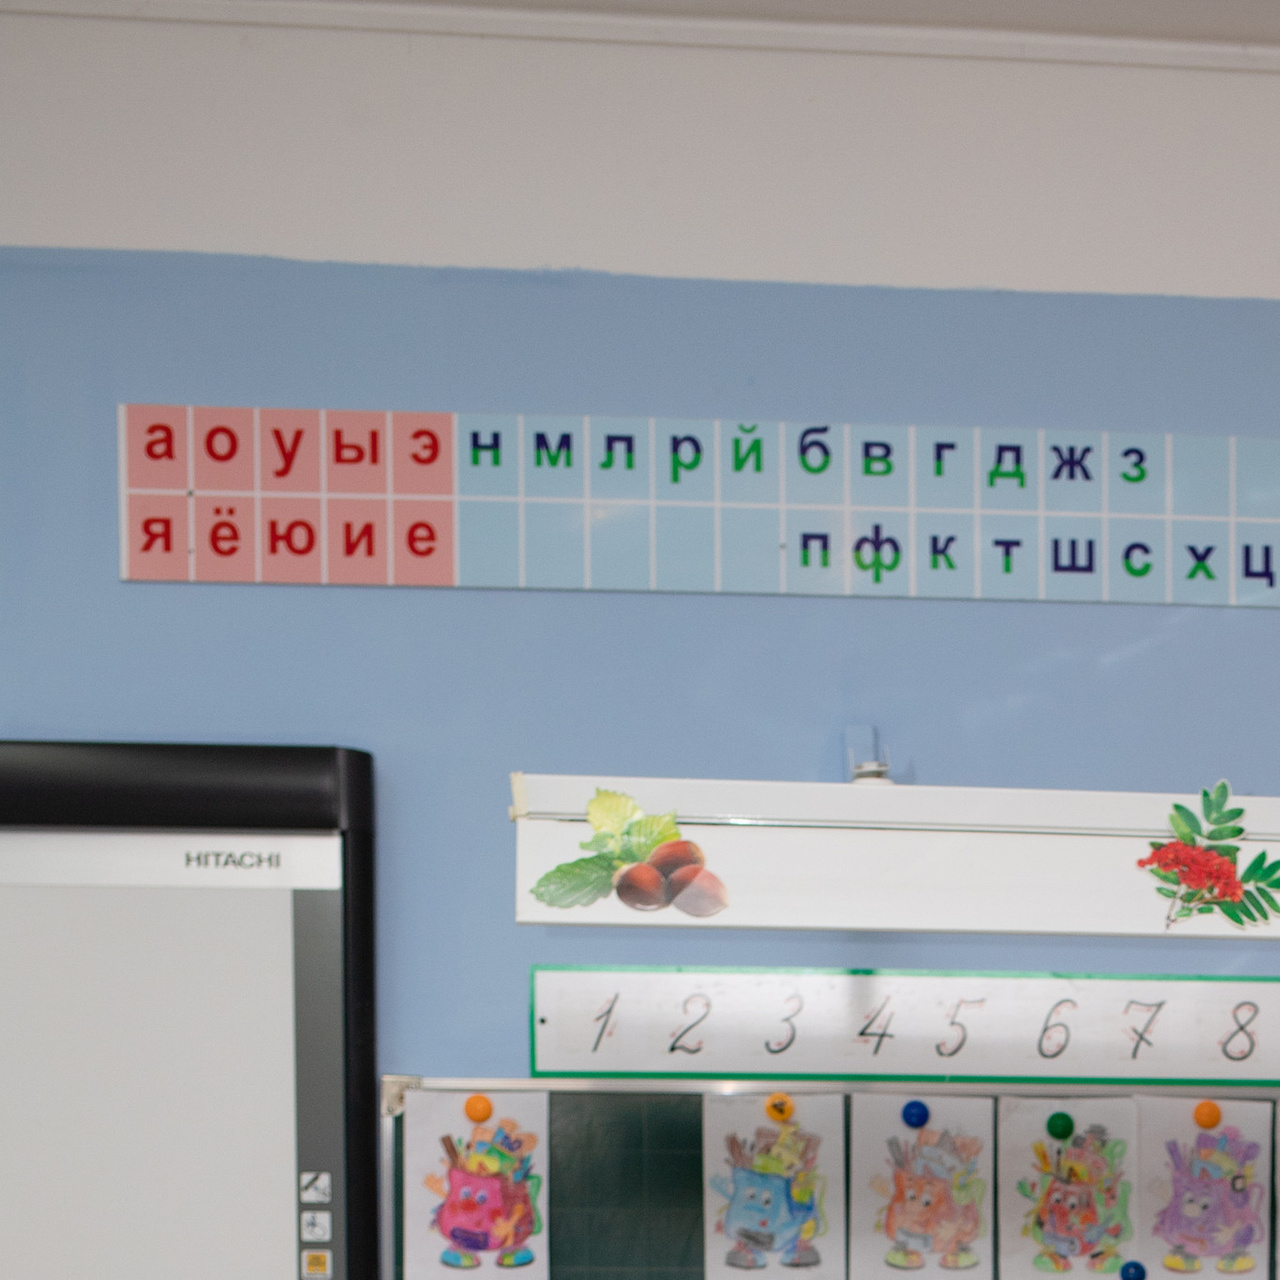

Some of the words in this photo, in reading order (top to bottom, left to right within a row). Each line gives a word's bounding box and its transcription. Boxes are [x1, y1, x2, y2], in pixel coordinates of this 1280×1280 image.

[143, 422, 176, 462] а
[204, 425, 239, 463] о
[272, 426, 304, 479] у
[332, 428, 380, 466] ы
[410, 428, 441, 466] э
[470, 430, 502, 467] н
[533, 431, 573, 468] м
[598, 433, 635, 471] л
[668, 433, 702, 484] р
[731, 423, 764, 474] й
[799, 426, 831, 475] б
[863, 441, 895, 477] в
[934, 442, 957, 478] г
[989, 444, 1026, 488] д
[1050, 446, 1093, 481] ж
[1121, 447, 1149, 483] з
[141, 517, 173, 553] я
[210, 508, 241, 557] ё
[268, 520, 315, 555] ю
[344, 522, 375, 557] и
[406, 521, 437, 557] е
[801, 533, 830, 567] п
[854, 525, 902, 583] ф
[931, 535, 957, 571] к
[994, 538, 1023, 574] т
[1052, 538, 1097, 574] ш
[1122, 541, 1152, 578] с
[1186, 543, 1217, 581] х
[1243, 545, 1275, 588] ц
[185, 852, 281, 868] HITACHI
[592, 993, 618, 1054] 1
[669, 994, 711, 1056] 2
[765, 994, 804, 1055] 3
[858, 994, 896, 1057] 4
[935, 999, 985, 1058] 5
[1037, 999, 1077, 1059] 6
[1122, 1000, 1166, 1060] 7
[1221, 1001, 1259, 1062] 8
